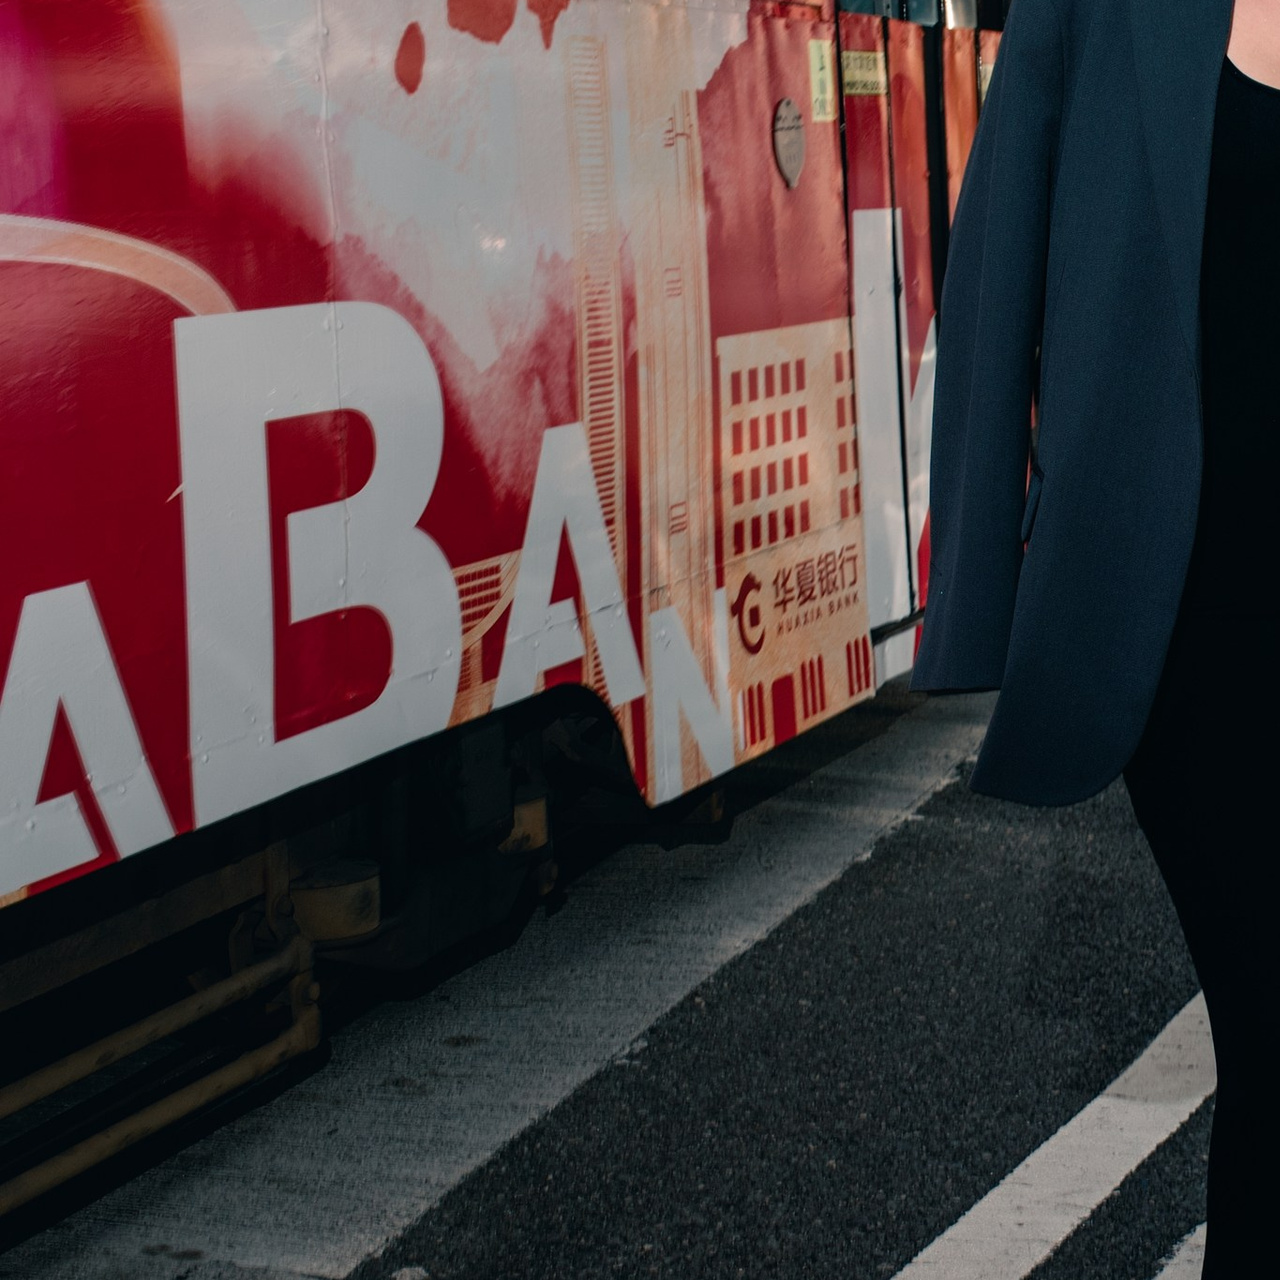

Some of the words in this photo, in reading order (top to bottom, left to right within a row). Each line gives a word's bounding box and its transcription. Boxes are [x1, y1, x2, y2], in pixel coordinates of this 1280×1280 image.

[772, 544, 858, 614] 华夏银行
[777, 607, 822, 637] HUAXIA
[828, 591, 859, 616] BANK
